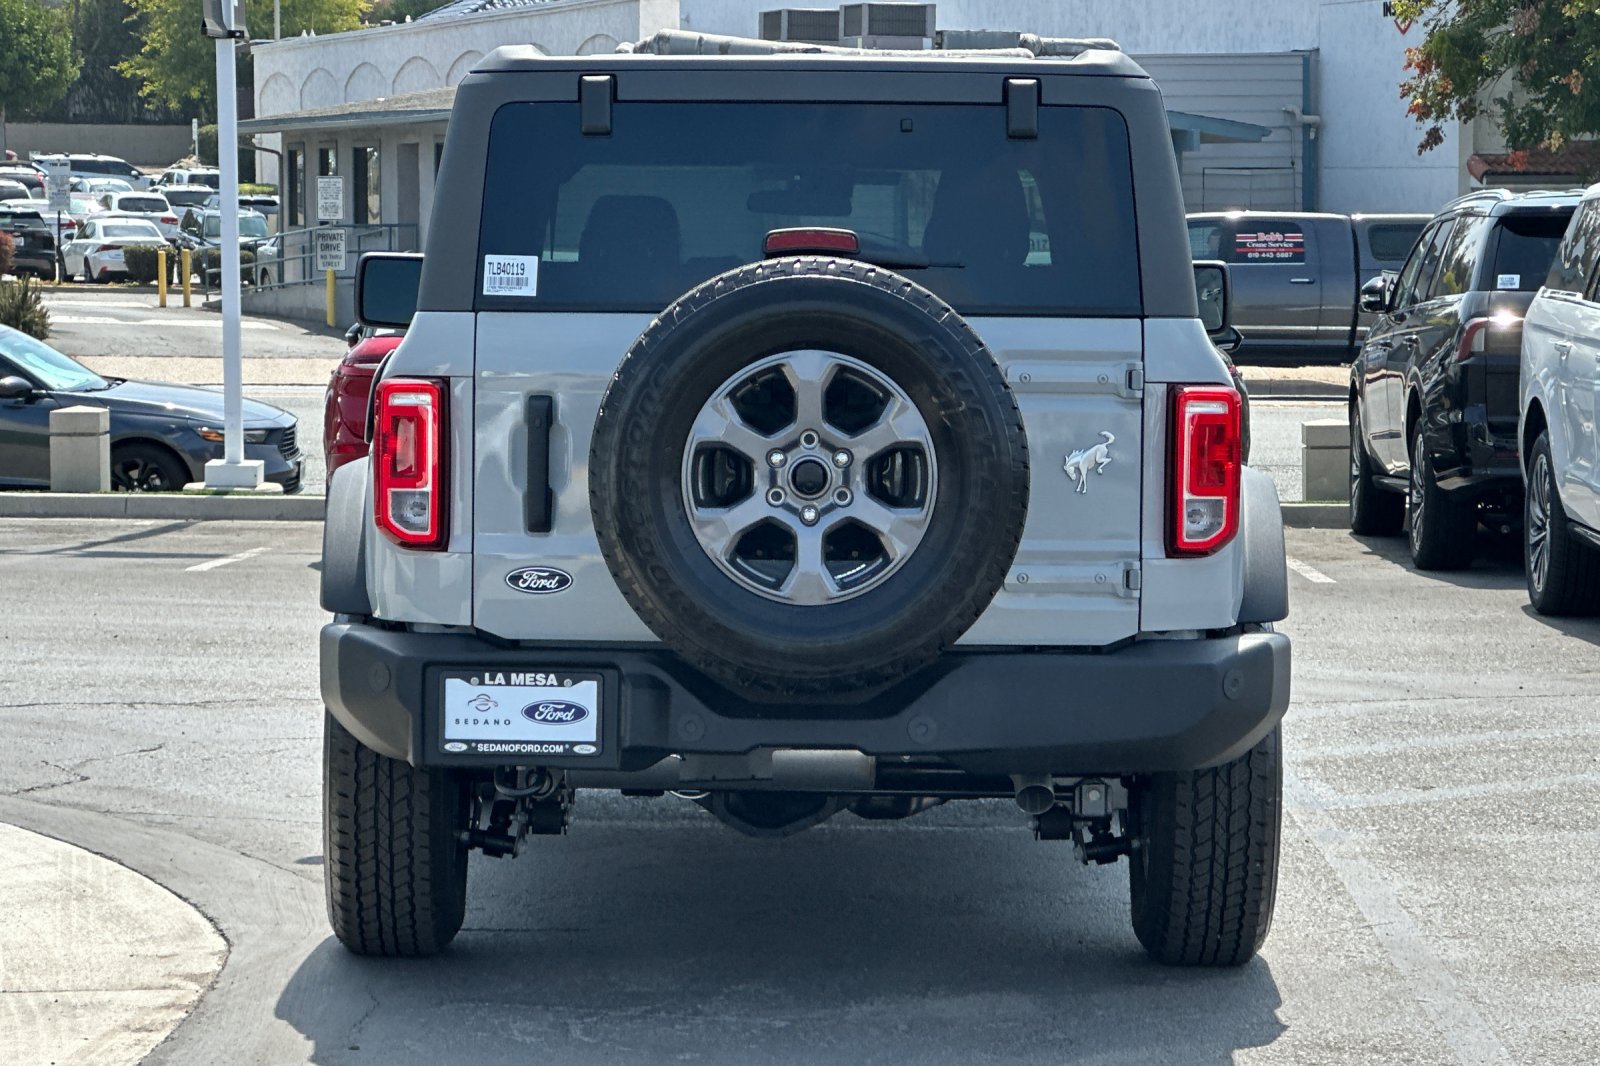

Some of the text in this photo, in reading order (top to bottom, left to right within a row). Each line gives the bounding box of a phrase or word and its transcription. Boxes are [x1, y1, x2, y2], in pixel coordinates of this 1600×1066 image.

[317, 232, 344, 242] PRIVATE
[320, 243, 341, 252] DRIVE
[321, 260, 341, 268] STREET
[487, 261, 526, 276] TLB40119
[518, 570, 560, 589] Ford
[484, 672, 558, 686] LA MESA
[534, 702, 576, 721] Ford
[455, 718, 511, 726] SEDANO
[477, 742, 564, 753] SEDANOFORD.COM
